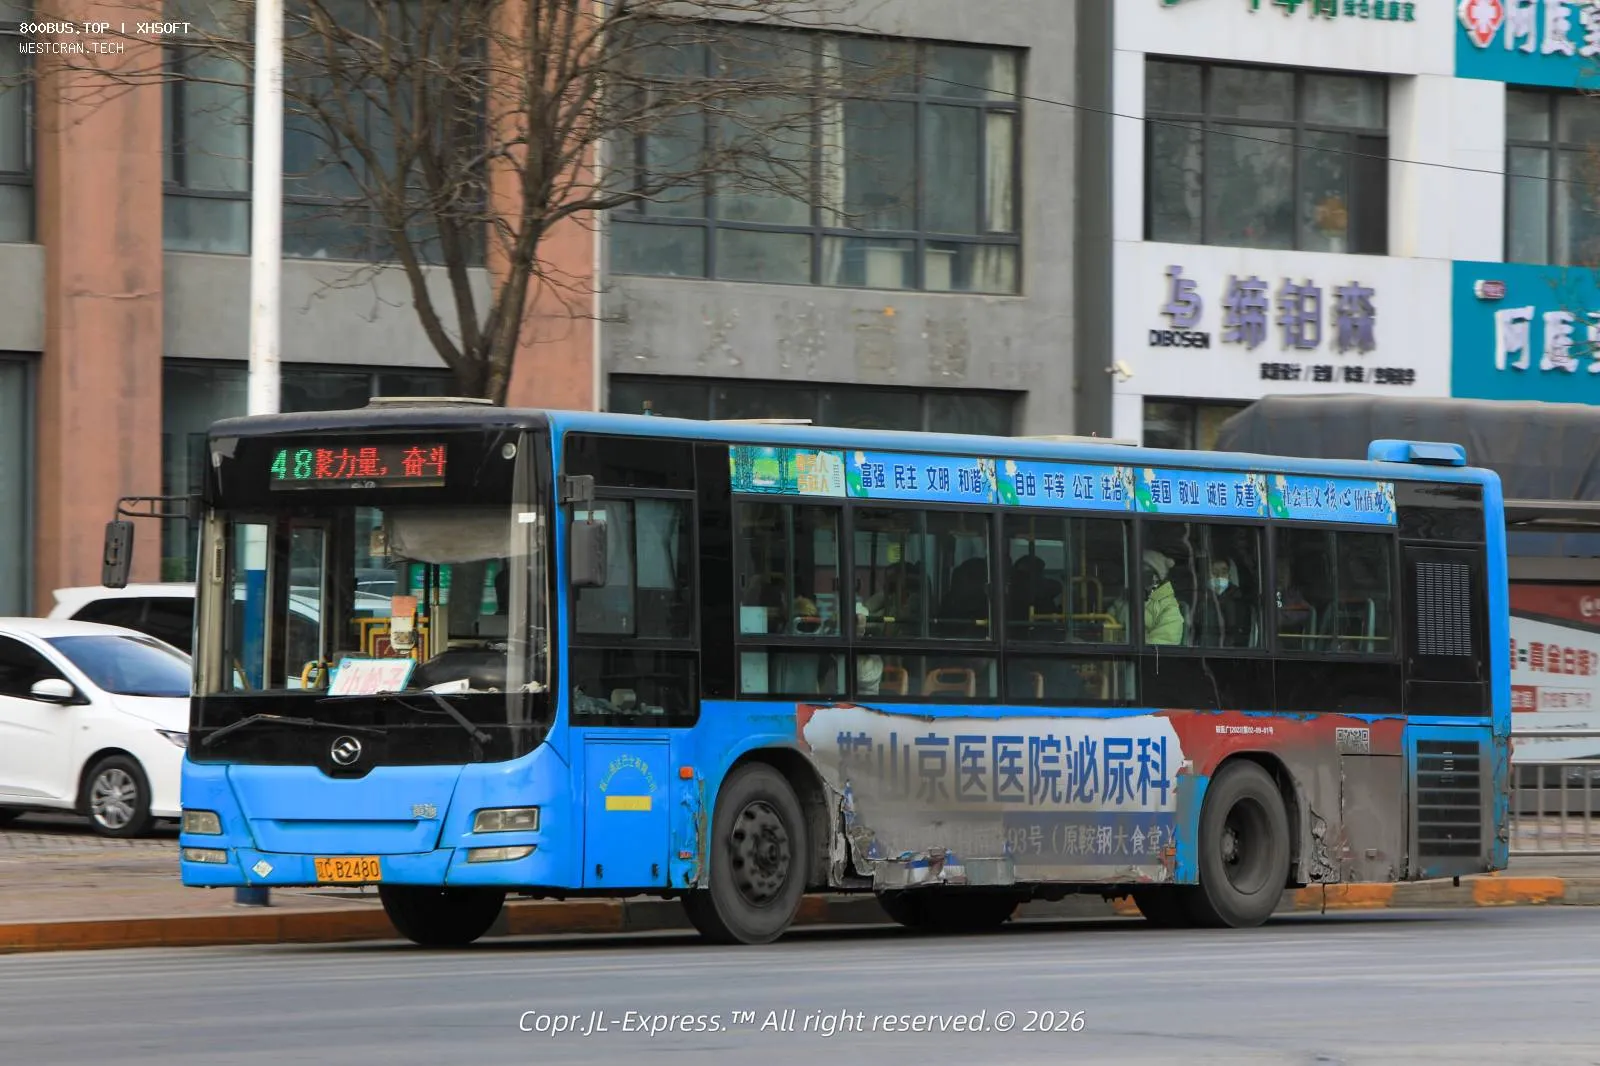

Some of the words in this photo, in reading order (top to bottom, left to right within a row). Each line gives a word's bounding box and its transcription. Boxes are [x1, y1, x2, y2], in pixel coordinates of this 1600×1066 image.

[1221, 275, 1376, 355] 缔铂森
[1149, 329, 1210, 349] DIBOSEN
[271, 449, 313, 480] 48
[860, 462, 885, 490] 富强
[894, 465, 918, 491] 民主
[926, 466, 951, 493] 文明
[958, 468, 983, 495] 和谐
[1015, 471, 1036, 497] 自由
[1043, 473, 1066, 500] 平等
[1072, 474, 1094, 501] 公正
[1101, 476, 1123, 503] 法治
[1151, 479, 1172, 505] 爱国
[1179, 480, 1200, 506] 敬业
[1206, 481, 1227, 508] 诚信
[1234, 482, 1256, 509] 友善
[1282, 480, 1385, 513] 社会主义核心价值观
[837, 731, 1171, 806] 鞍山京医医院泌尿科
